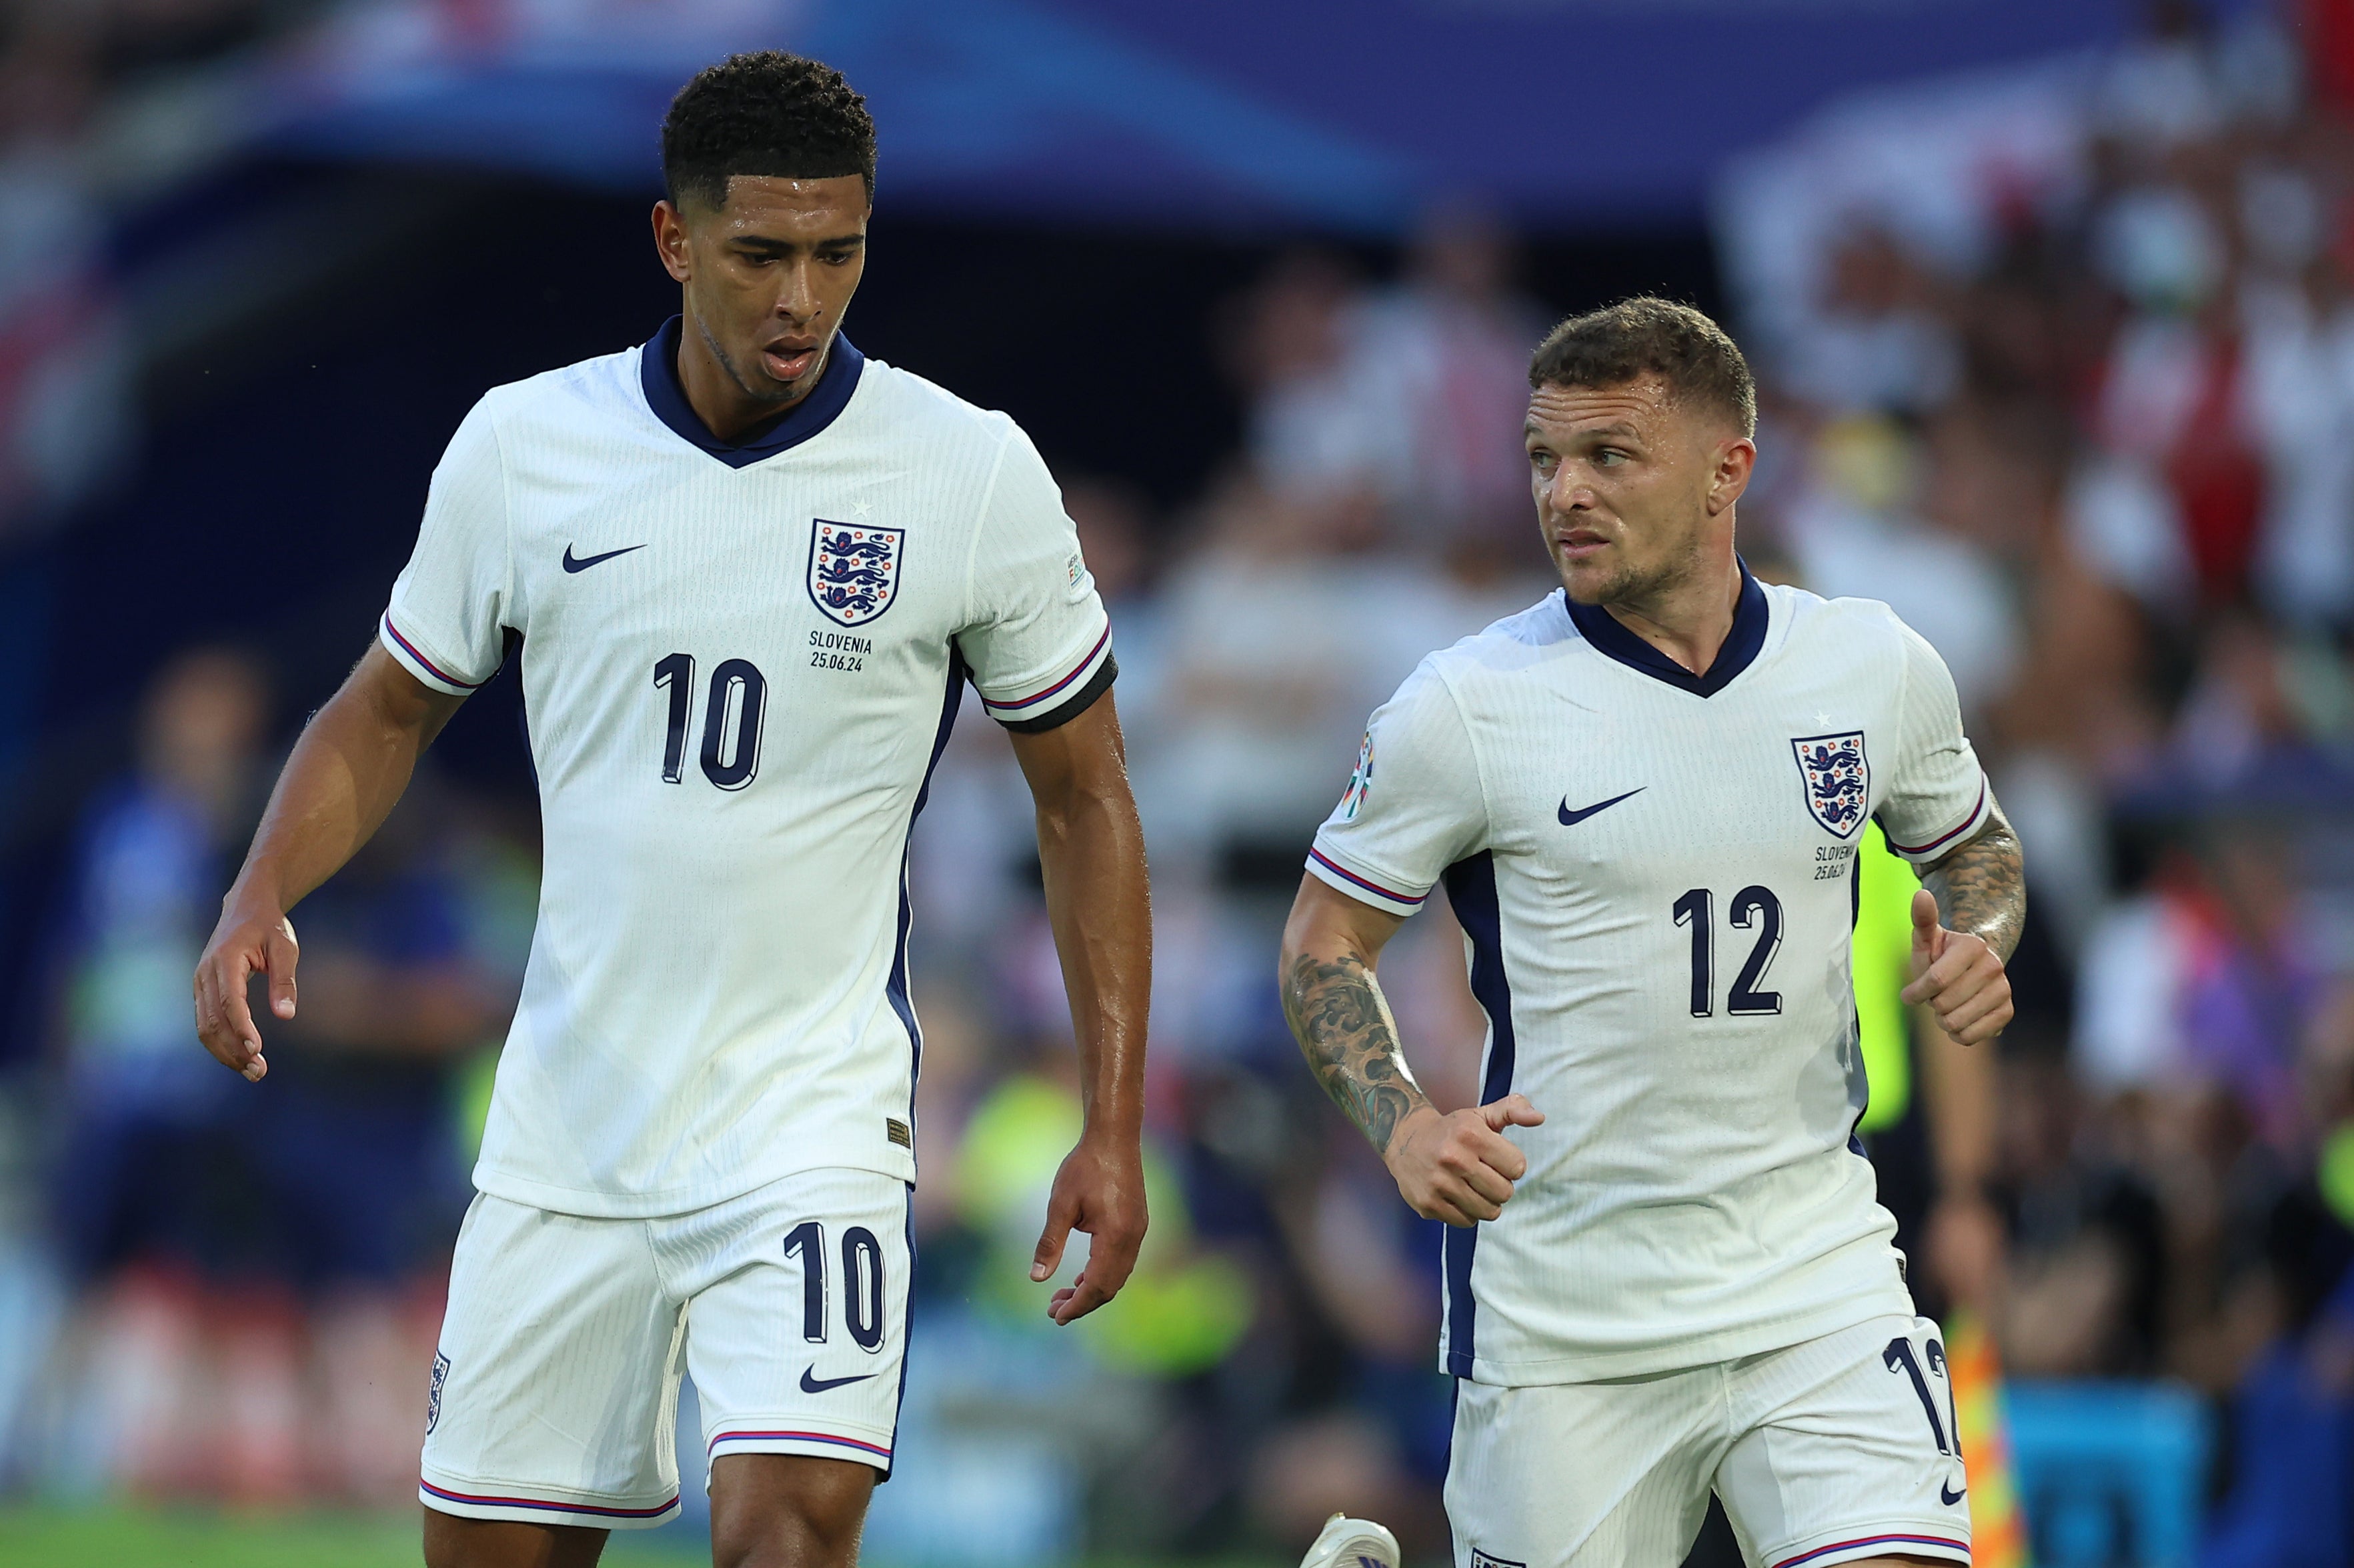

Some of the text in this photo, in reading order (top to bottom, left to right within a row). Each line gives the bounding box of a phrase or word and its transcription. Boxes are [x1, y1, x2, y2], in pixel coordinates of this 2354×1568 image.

[809, 630, 872, 655] SLOVENIA
[810, 651, 863, 673] 25.06.24
[654, 652, 768, 792] 10
[1672, 885, 1785, 1018] 12
[784, 1221, 886, 1355] 10
